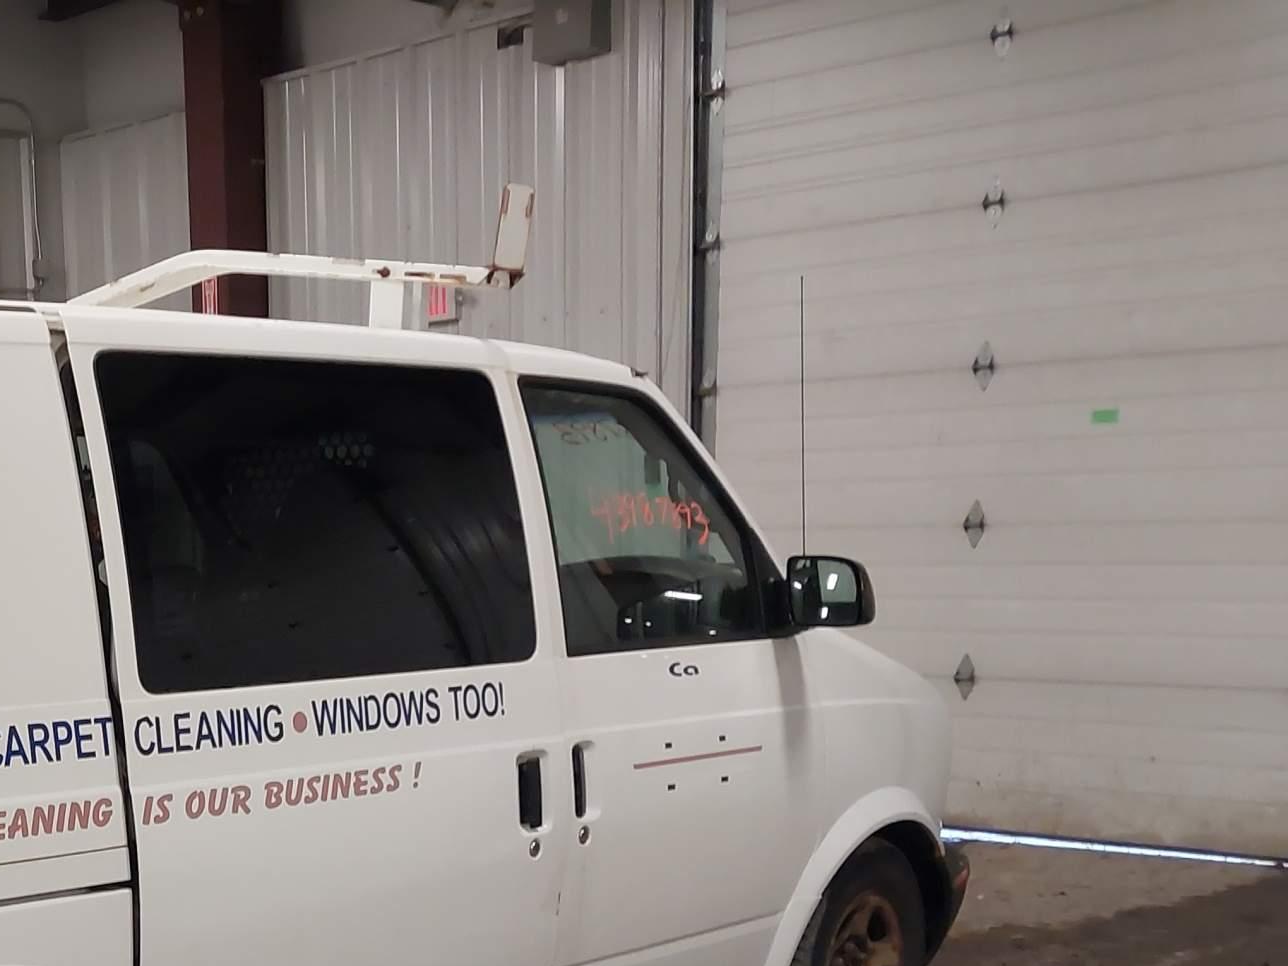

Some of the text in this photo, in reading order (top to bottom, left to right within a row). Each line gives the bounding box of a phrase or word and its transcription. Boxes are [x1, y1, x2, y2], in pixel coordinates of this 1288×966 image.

[134, 704, 285, 756] CLEANING
[311, 688, 441, 737] WINDOWS
[447, 681, 505, 721] TOO!
[141, 794, 173, 825] IS
[185, 785, 252, 820] OUR
[264, 764, 402, 809] BUSINESS
